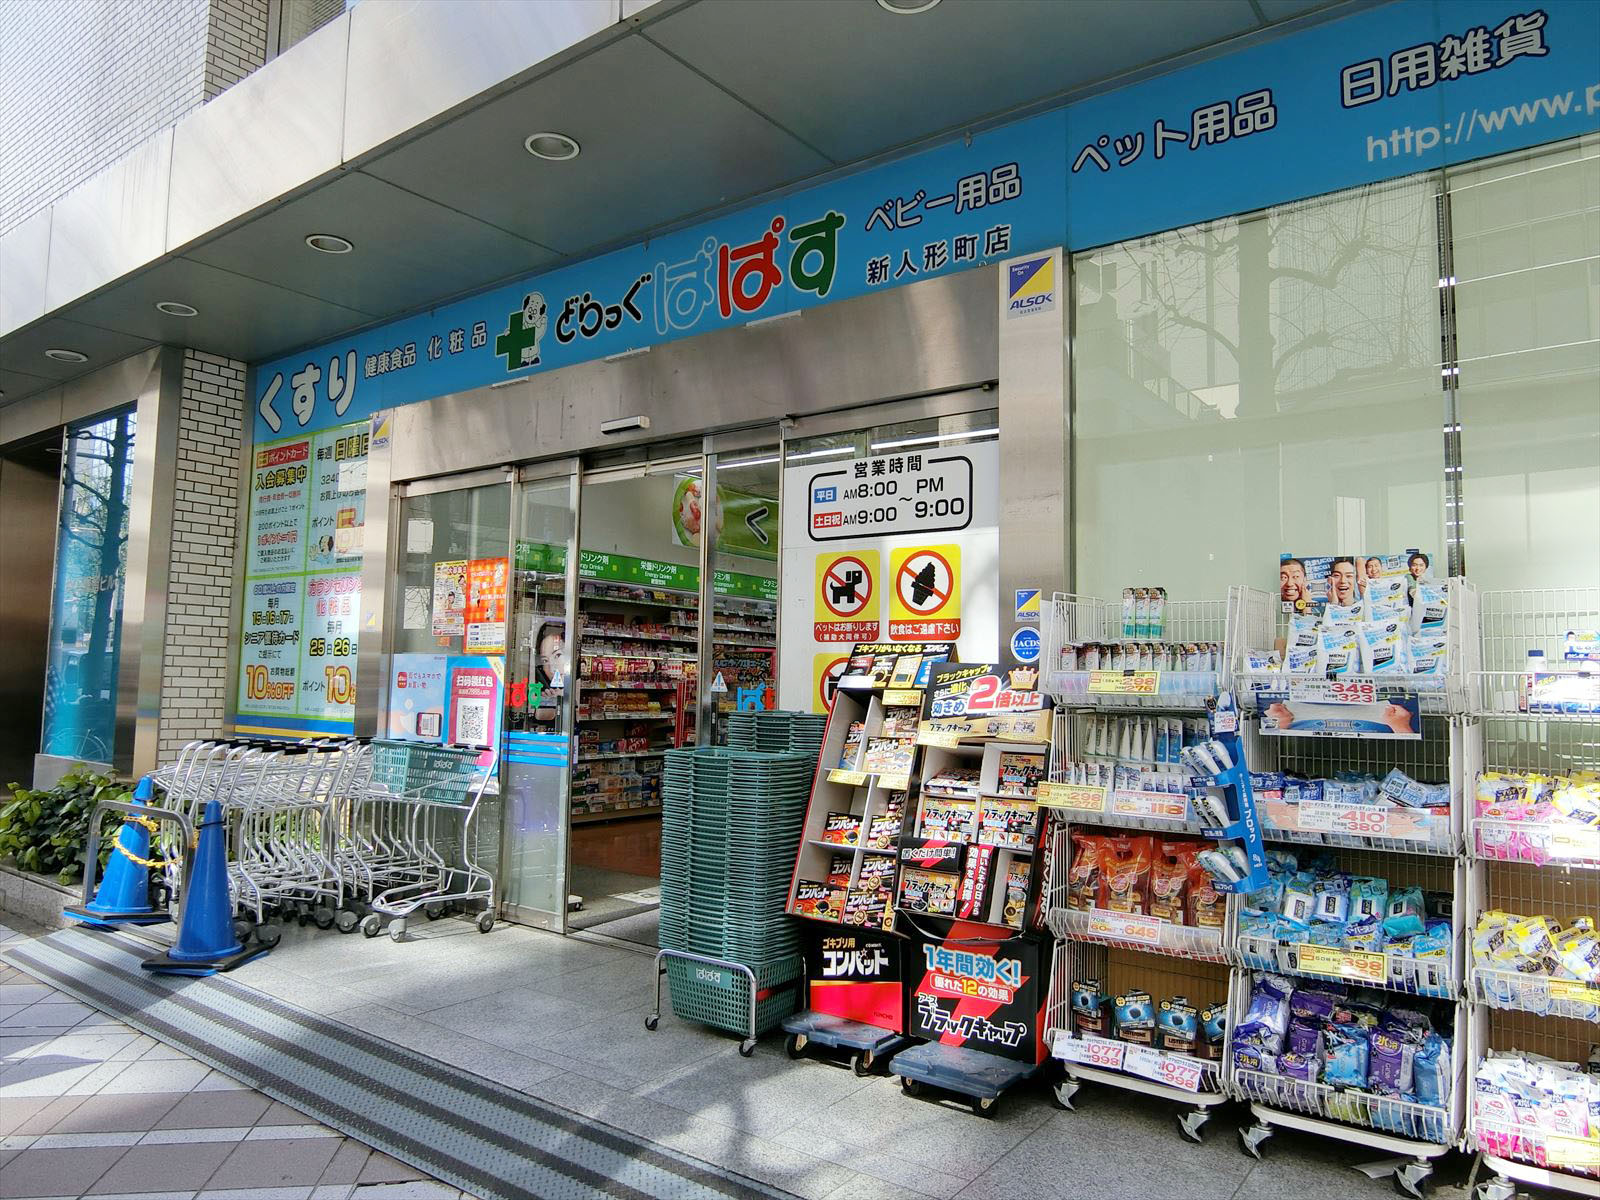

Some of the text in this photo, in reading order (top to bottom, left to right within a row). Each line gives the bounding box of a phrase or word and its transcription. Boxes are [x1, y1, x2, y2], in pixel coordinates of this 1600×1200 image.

[1340, 9, 1550, 109] 日用雑貨
[1072, 87, 1278, 174] ペット用品
[865, 162, 1022, 233] ベビー用品
[865, 224, 1011, 286] 新人形町店
[555, 272, 652, 345] どらっぐ
[1010, 293, 1053, 310] ALSOK
[427, 320, 488, 362] 化粧品
[364, 342, 418, 378] 健康食品
[258, 348, 357, 434] くすり
[854, 454, 923, 479] 営業時間
[255, 465, 307, 491] 入会募集中
[916, 477, 944, 494] PM
[816, 489, 834, 501] 平日
[843, 480, 898, 501] AM8:00
[914, 497, 965, 519] 9:00
[312, 517, 334, 528] ポイント
[815, 514, 842, 528] 土日祝
[843, 506, 898, 526] AM9:00
[889, 622, 959, 635] 飲食はご遠慮下さい
[854, 644, 922, 653] ゴキブリがいなくなる
[302, 680, 326, 692] ポイント
[1330, 683, 1374, 694] 348
[1338, 693, 1374, 703] 323
[925, 808, 975, 821] ブラックキャップ
[983, 808, 1037, 822] ブラックキャップ
[1339, 811, 1386, 824] 410
[827, 818, 859, 831] コンバット
[1347, 822, 1384, 834] 380
[861, 859, 893, 873] コンバット
[798, 887, 830, 900] コンバット
[905, 879, 952, 893] ブラックキャップ
[847, 893, 879, 906] コンバット
[822, 937, 856, 950] ゴキブリ用
[822, 948, 889, 977] コンバット
[922, 943, 1022, 988] 1年間効く!
[934, 977, 1010, 1002] 優れた12の効果
[918, 992, 939, 1007] アース
[918, 1006, 1028, 1047] ブラックキャップ
[1087, 1044, 1122, 1058] 1077
[1091, 1055, 1120, 1067] 998
[1160, 1061, 1199, 1080] 1077
[1165, 1074, 1195, 1089] 998
